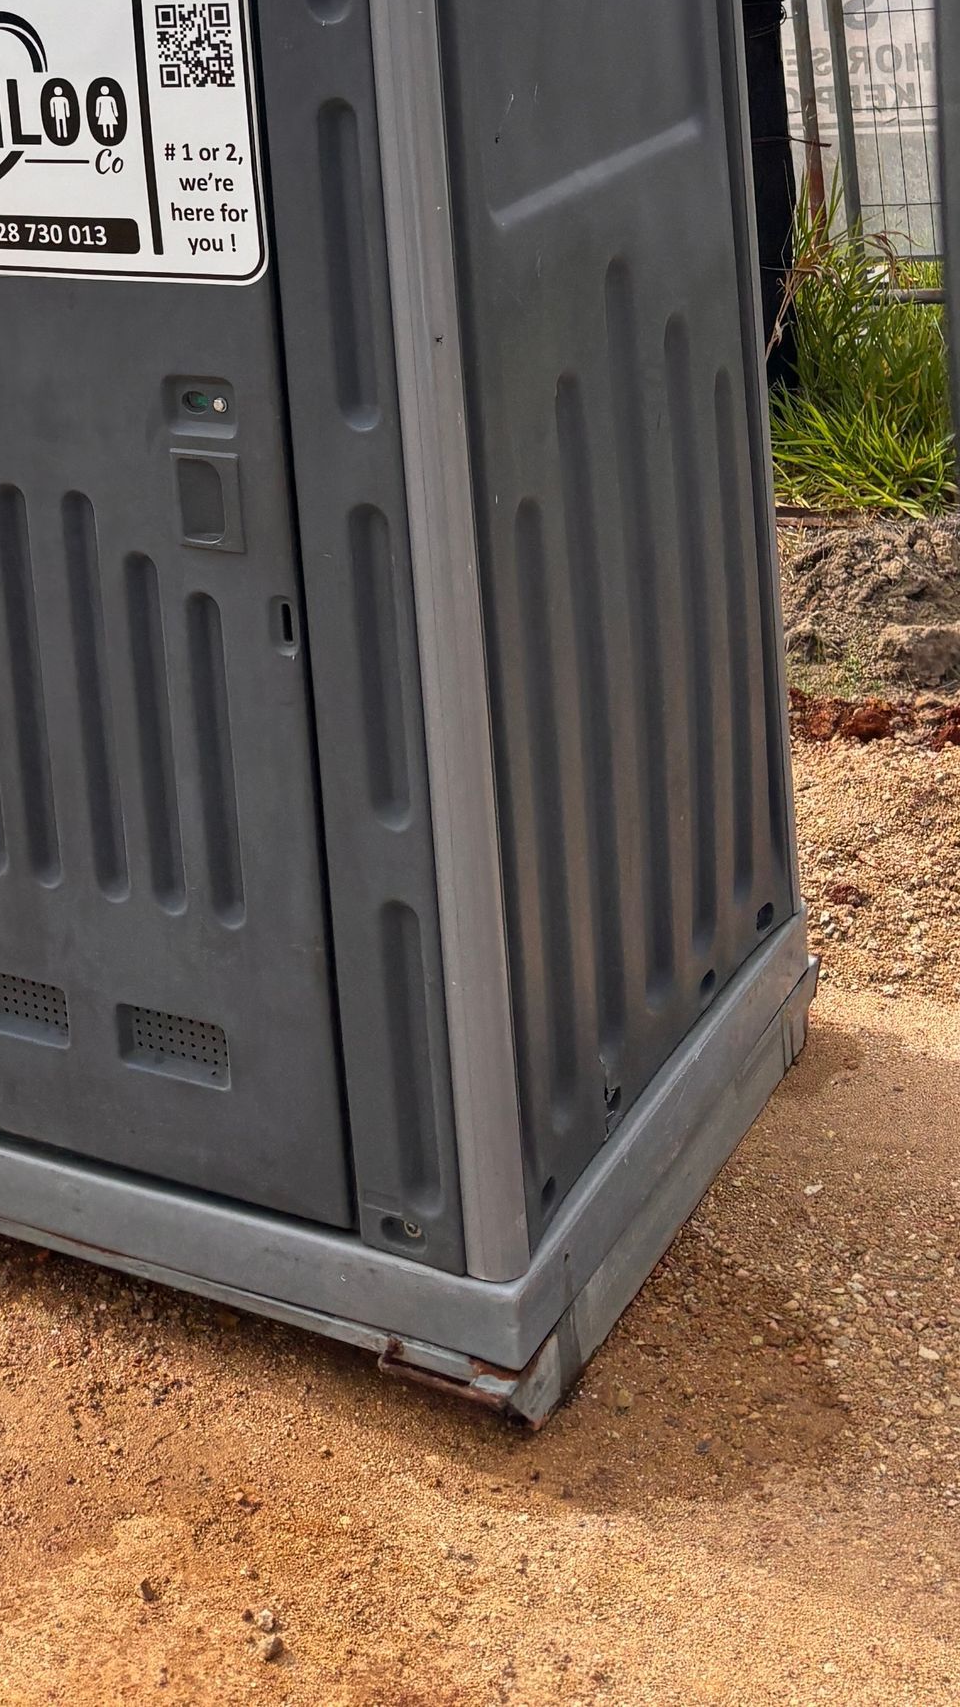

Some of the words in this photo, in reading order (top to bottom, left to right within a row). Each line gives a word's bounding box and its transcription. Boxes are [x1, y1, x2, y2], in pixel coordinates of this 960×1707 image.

[95, 148, 125, 175] Co
[164, 143, 176, 161] #
[182, 143, 194, 161] 1
[198, 147, 220, 162] or
[225, 142, 244, 166] 2,
[178, 172, 234, 192] we're
[170, 201, 215, 222] here
[219, 202, 249, 223] for
[24, 223, 63, 244] 730
[68, 224, 108, 246] 013
[187, 237, 224, 256] you
[230, 233, 237, 253] !
